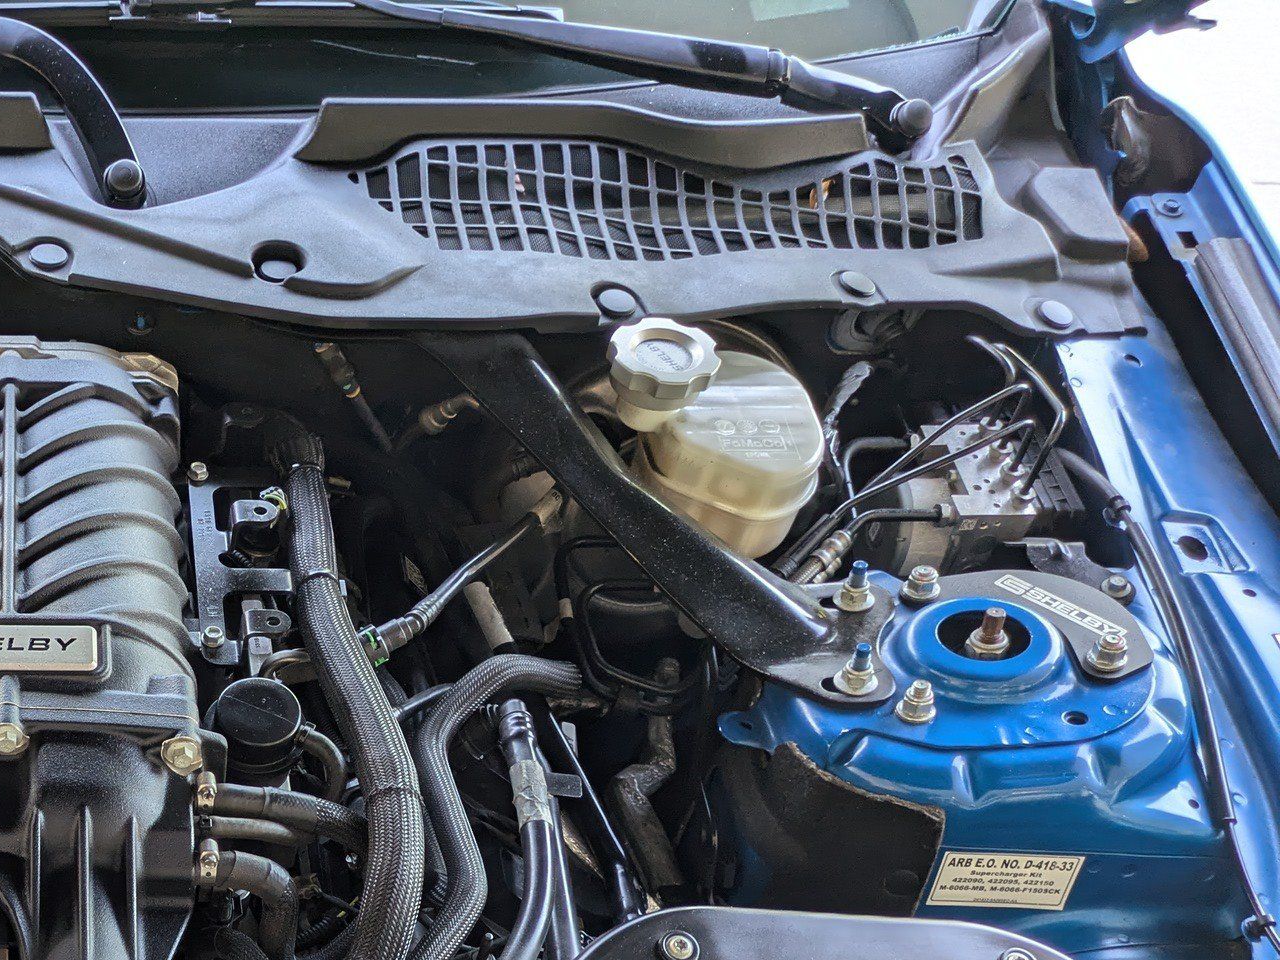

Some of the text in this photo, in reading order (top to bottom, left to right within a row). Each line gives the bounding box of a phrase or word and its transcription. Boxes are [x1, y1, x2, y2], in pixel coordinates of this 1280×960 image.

[1024, 588, 1119, 636] SHELBY
[948, 857, 1074, 871] ARB E.O. NO. D-418-33
[970, 870, 1027, 878] Supercharger
[952, 877, 985, 885] 422090,
